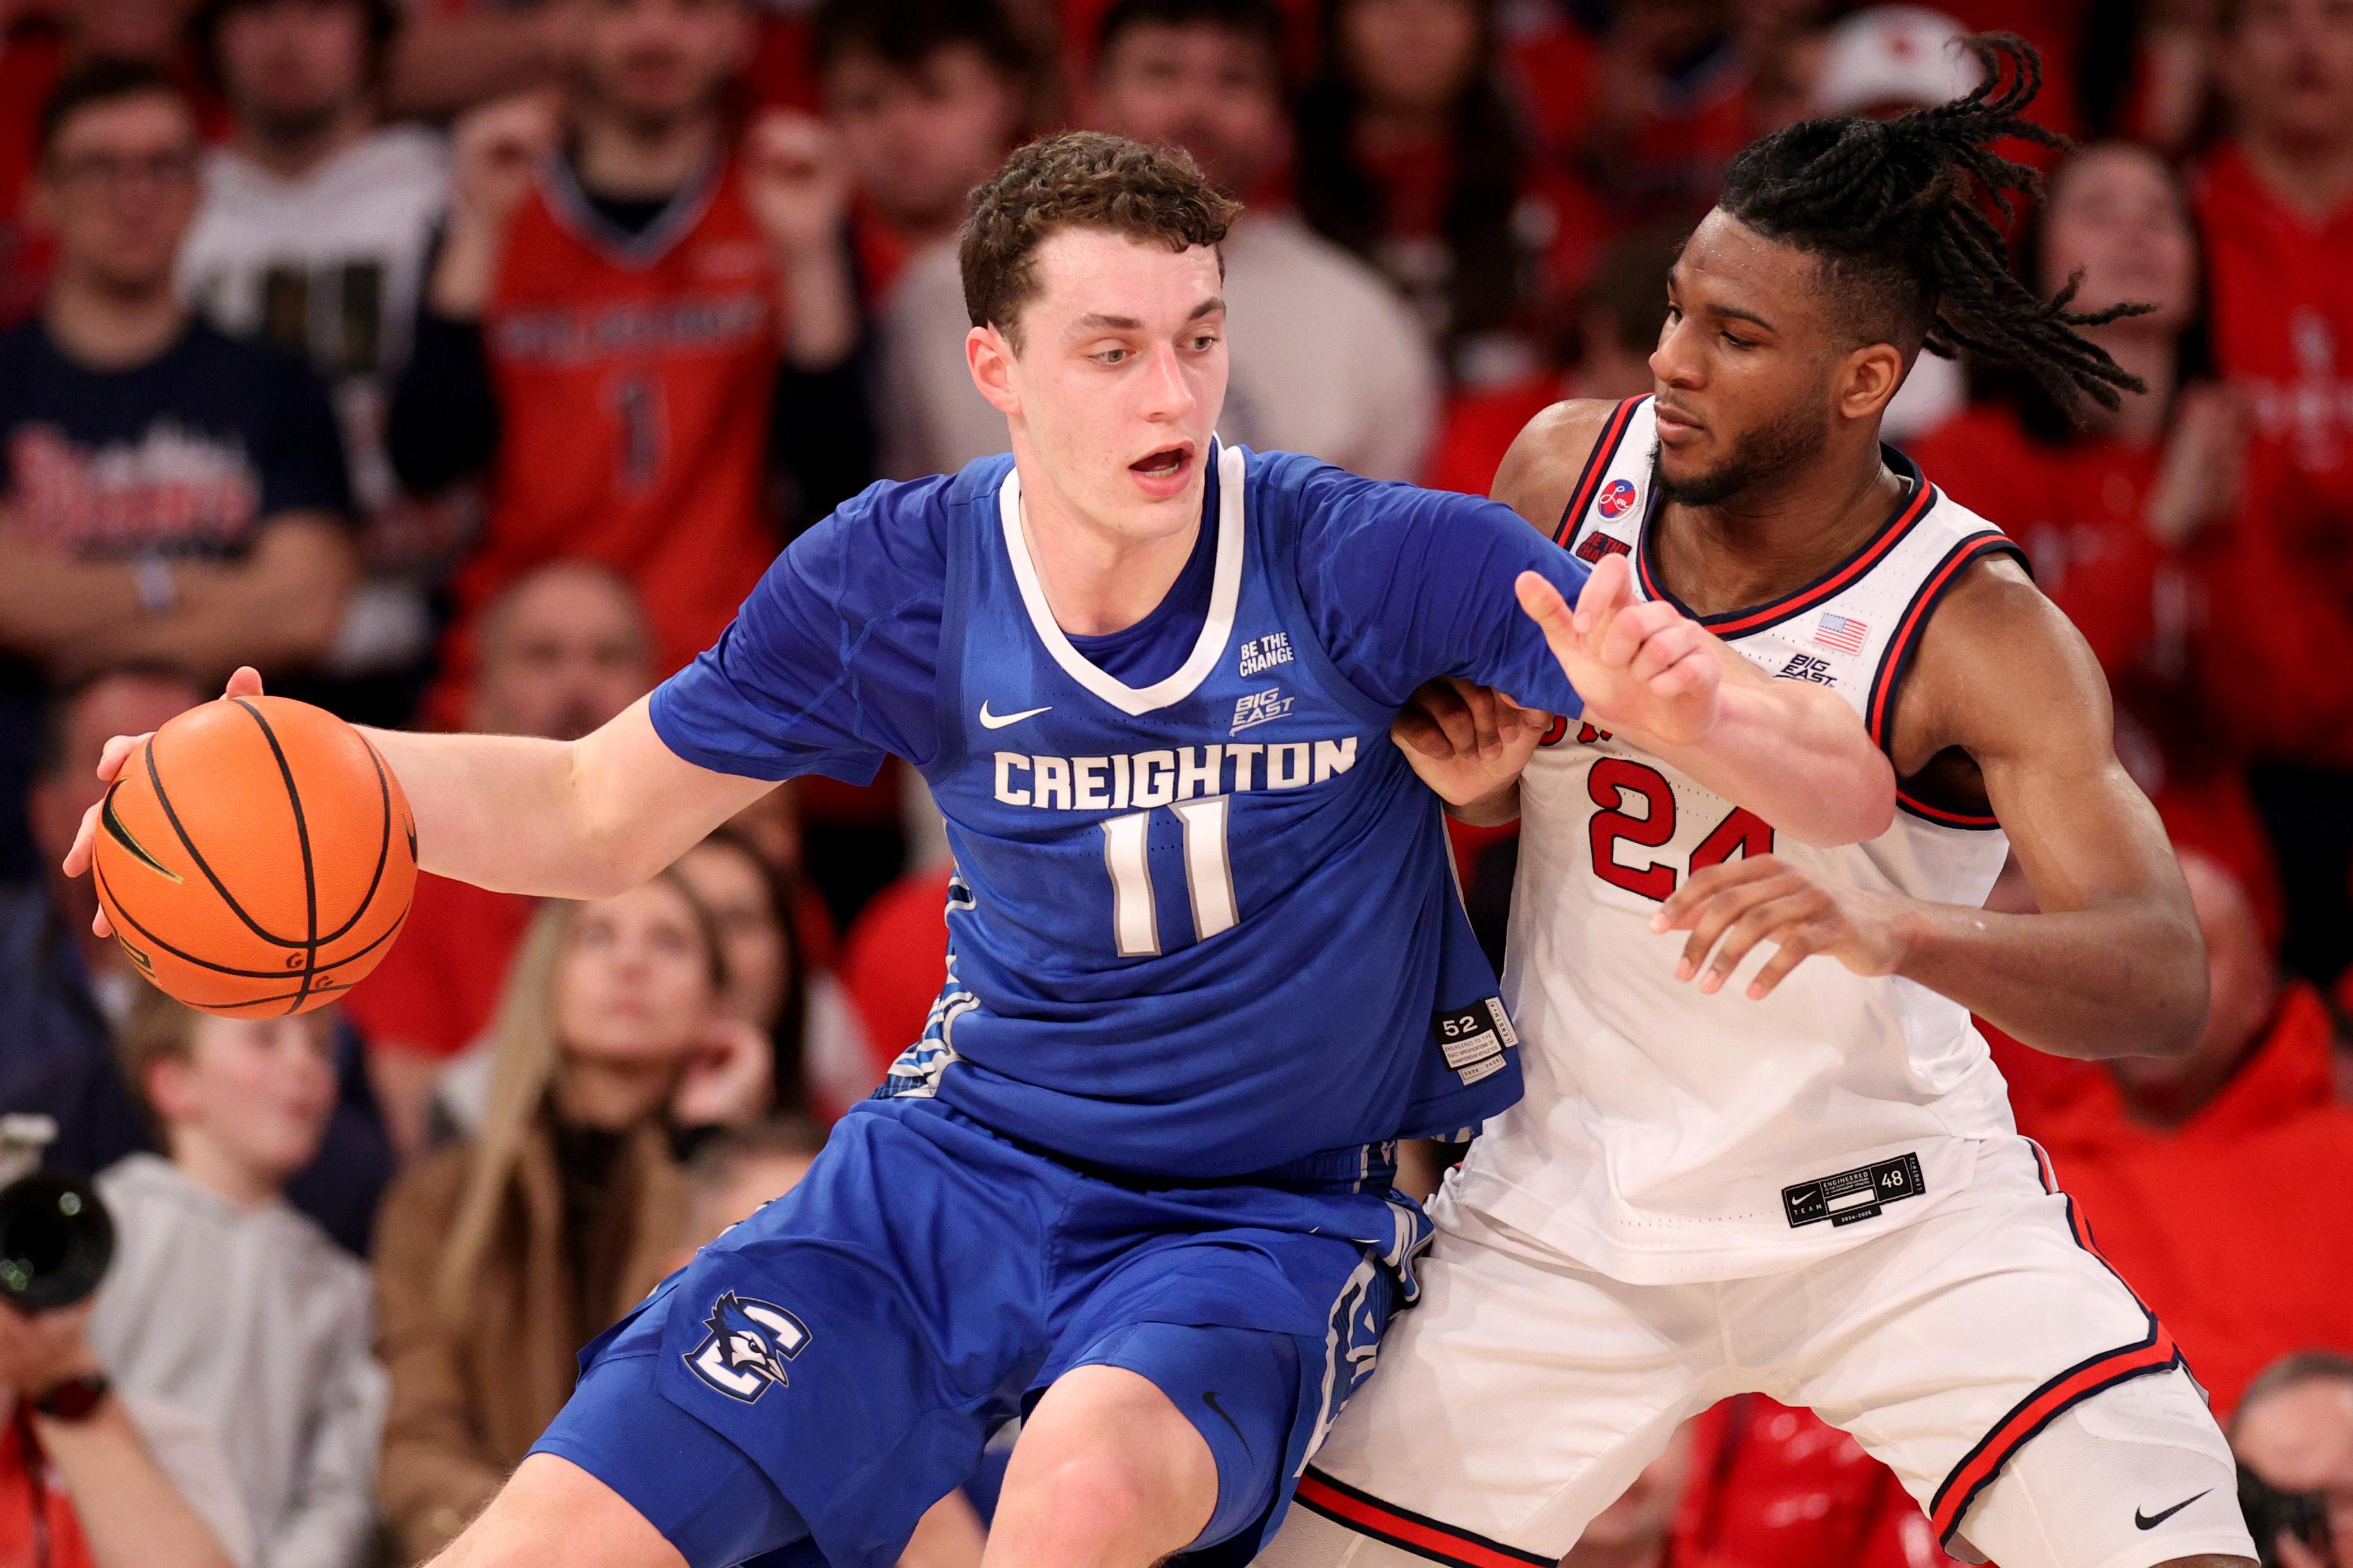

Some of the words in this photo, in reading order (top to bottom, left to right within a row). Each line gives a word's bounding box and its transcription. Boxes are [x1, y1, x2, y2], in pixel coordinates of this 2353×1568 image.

[1599, 486, 1630, 511] Lou
[1586, 532, 1603, 548] BE
[1240, 640, 1259, 660] BE
[1261, 632, 1289, 652] THE
[1239, 646, 1294, 677] CHANGE
[1789, 653, 1831, 672] BIG
[1780, 664, 1838, 686] EAST
[1235, 687, 1280, 712] BIG
[1232, 697, 1295, 726] EAST
[993, 736, 1358, 811] CREIGHTON
[1098, 794, 1240, 957] 11
[1442, 1015, 1479, 1036] 52
[1823, 1171, 1869, 1188] ENGINEERED
[1881, 1170, 1903, 1189] 48
[1793, 1203, 1822, 1215] TEAM
